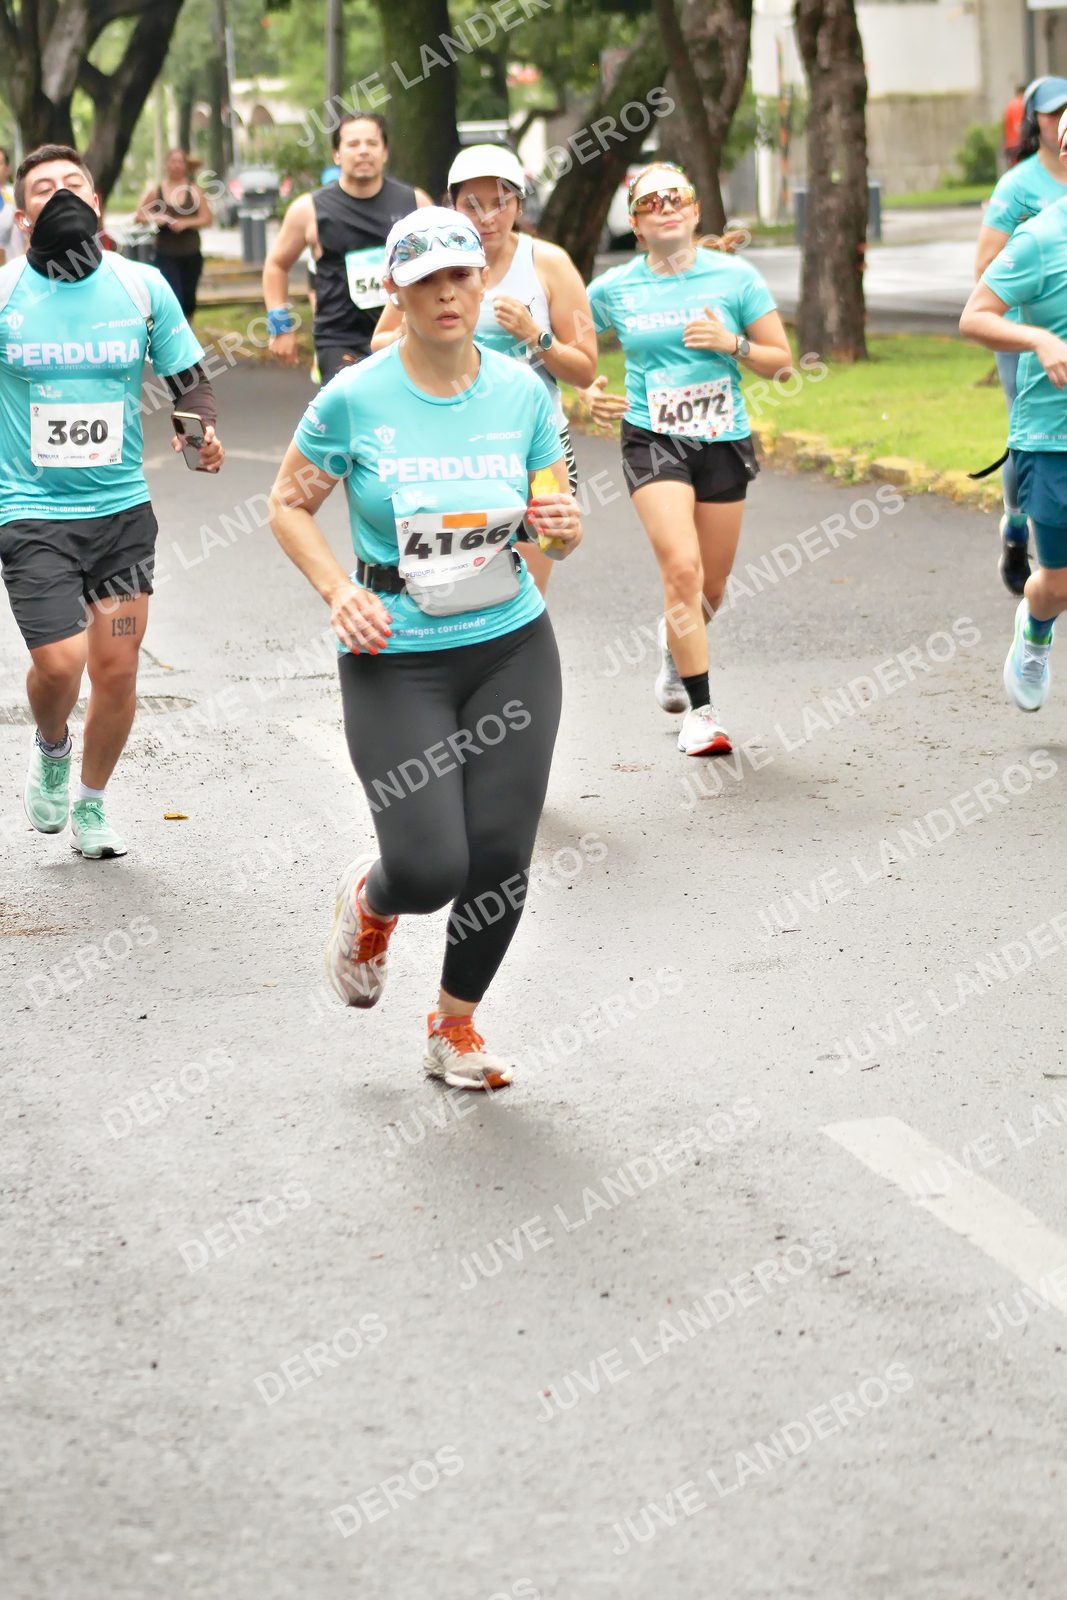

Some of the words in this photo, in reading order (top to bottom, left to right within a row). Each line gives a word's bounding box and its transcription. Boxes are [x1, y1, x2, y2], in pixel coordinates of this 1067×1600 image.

[356, 277, 384, 294] 54
[6, 338, 140, 366] PERDURA
[658, 393, 729, 426] 4072
[47, 419, 108, 446] 360
[486, 430, 523, 441] BROOKS
[378, 455, 524, 482] PERDURA
[404, 522, 513, 560] 4166
[112, 616, 137, 637] 1921
[437, 617, 486, 633] corriendo
